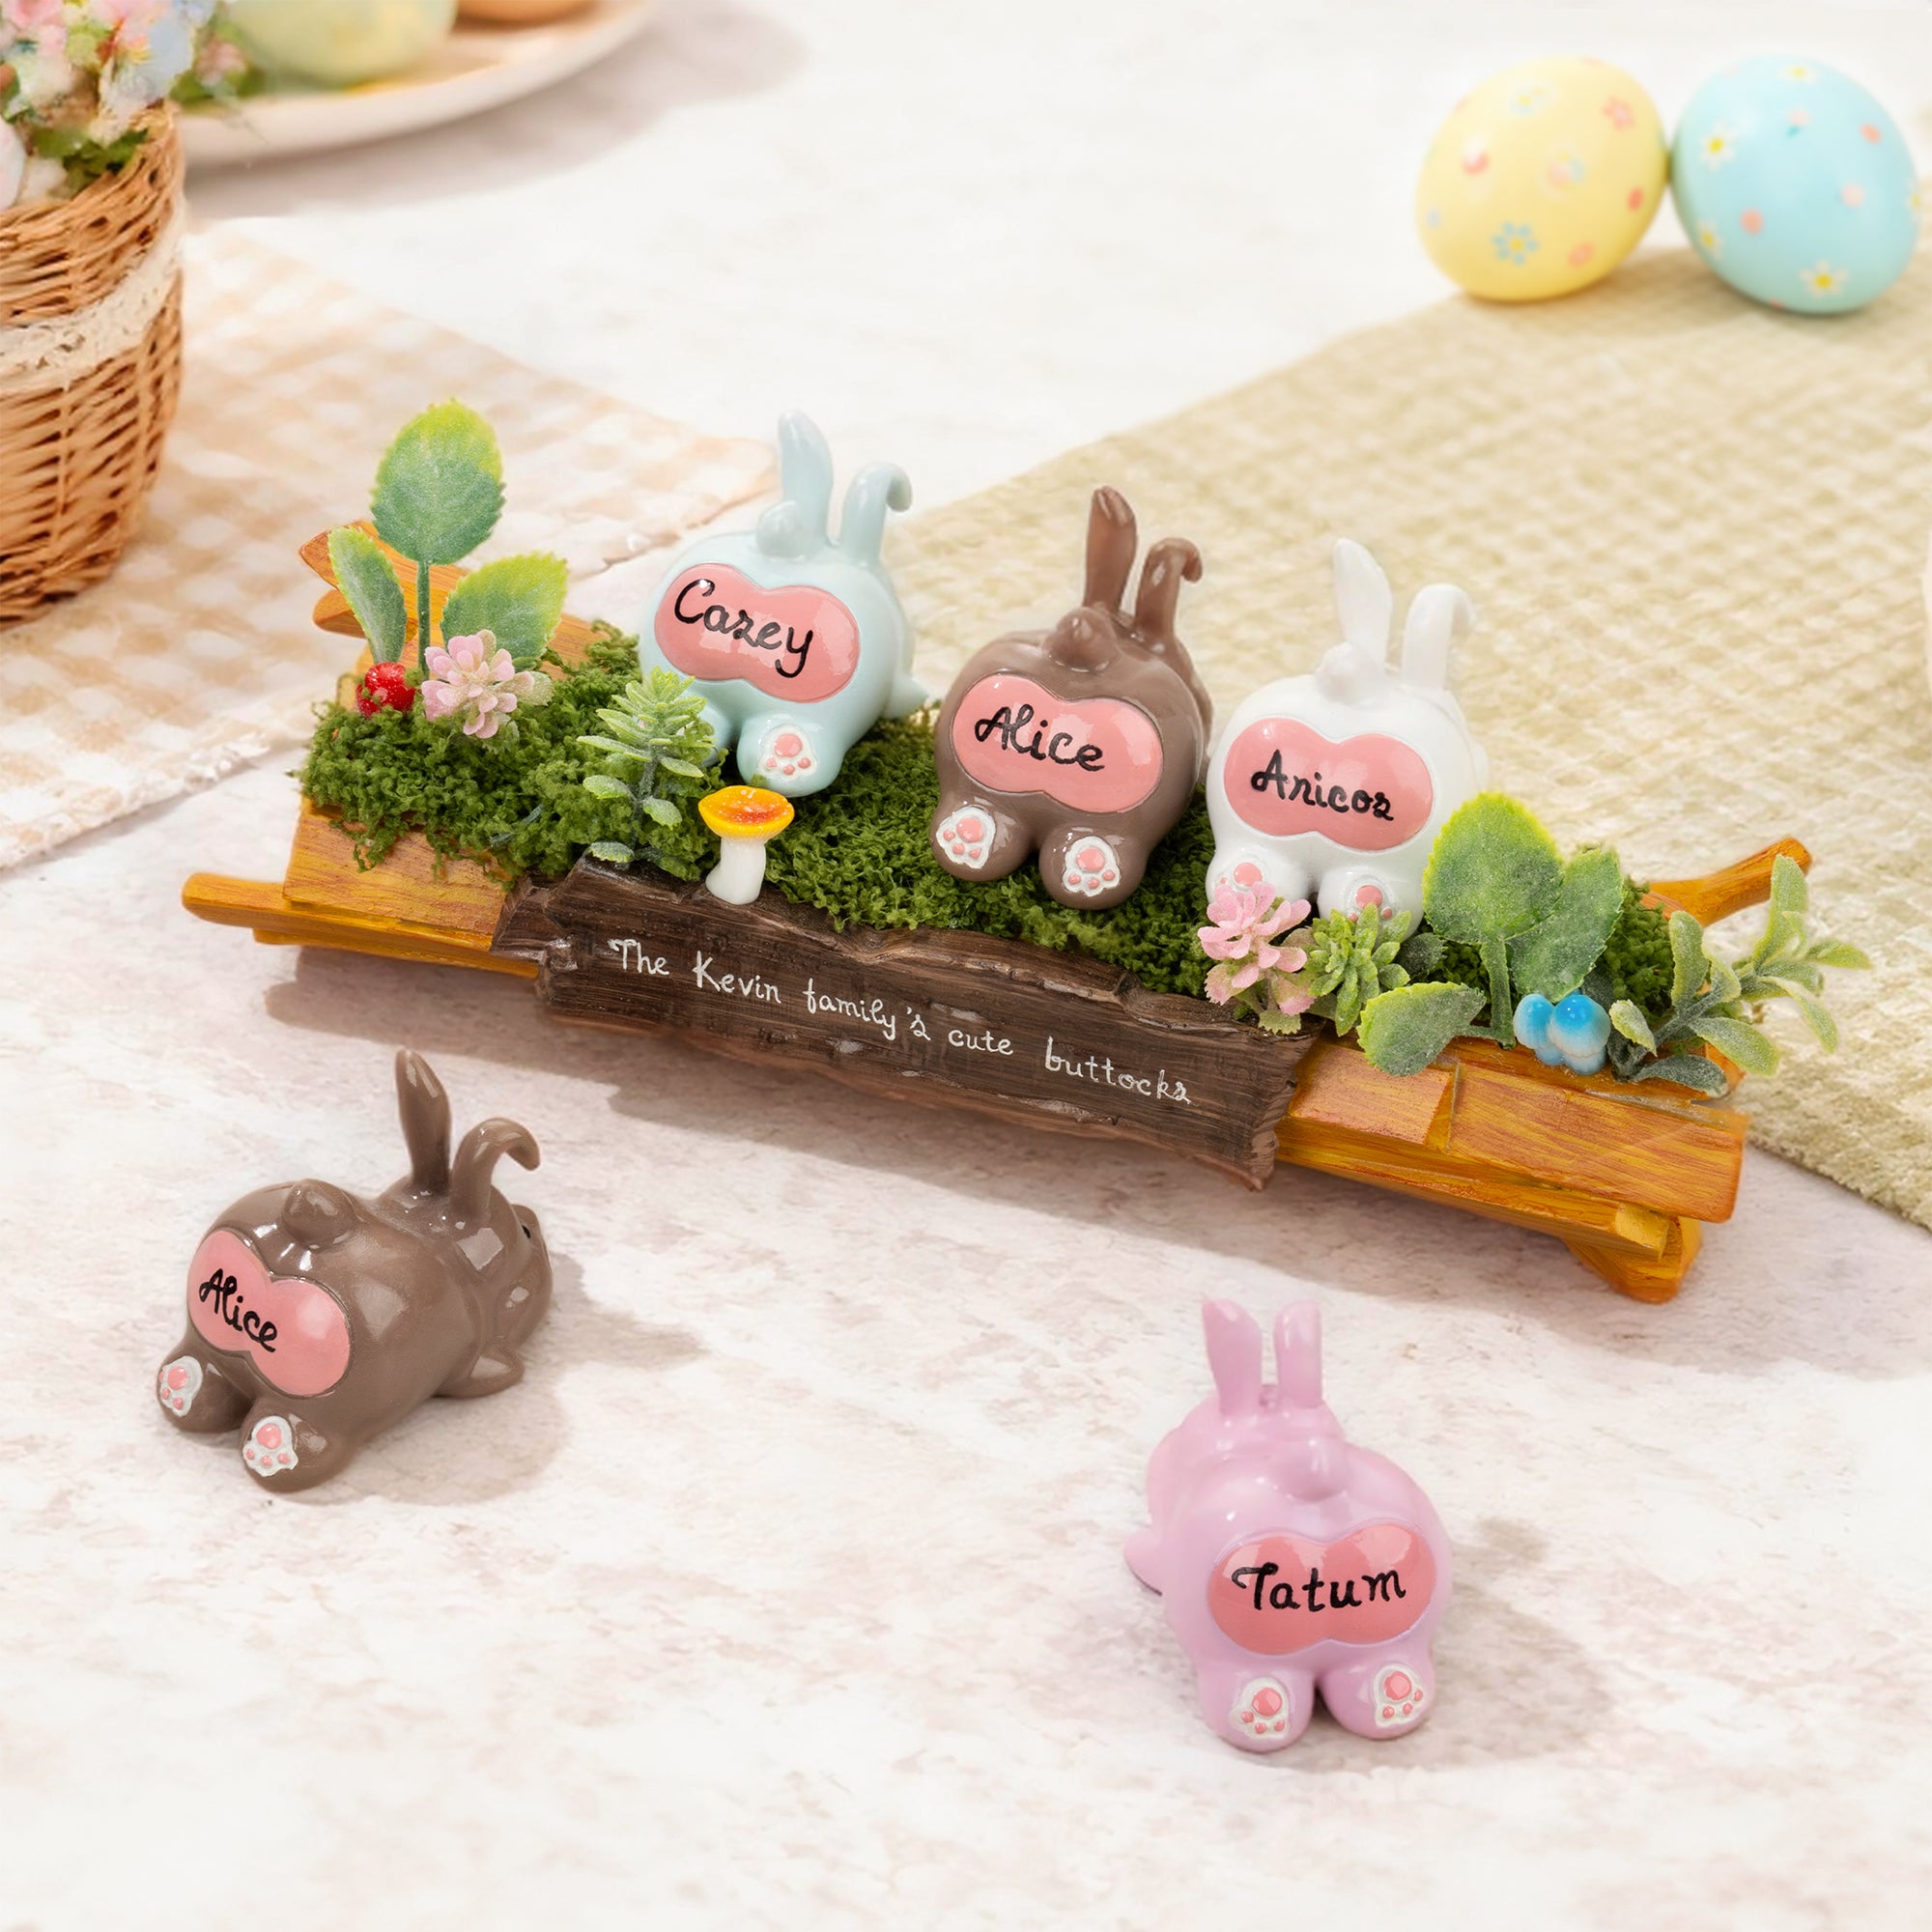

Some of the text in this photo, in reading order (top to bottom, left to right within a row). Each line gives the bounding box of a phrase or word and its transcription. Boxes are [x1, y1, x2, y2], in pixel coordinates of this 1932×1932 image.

[975, 703, 1105, 772] Alice
[608, 939, 1192, 1104] The Kevin family's cute buttocks
[199, 1268, 277, 1352] Alice
[1232, 1562, 1406, 1612] Tatum
